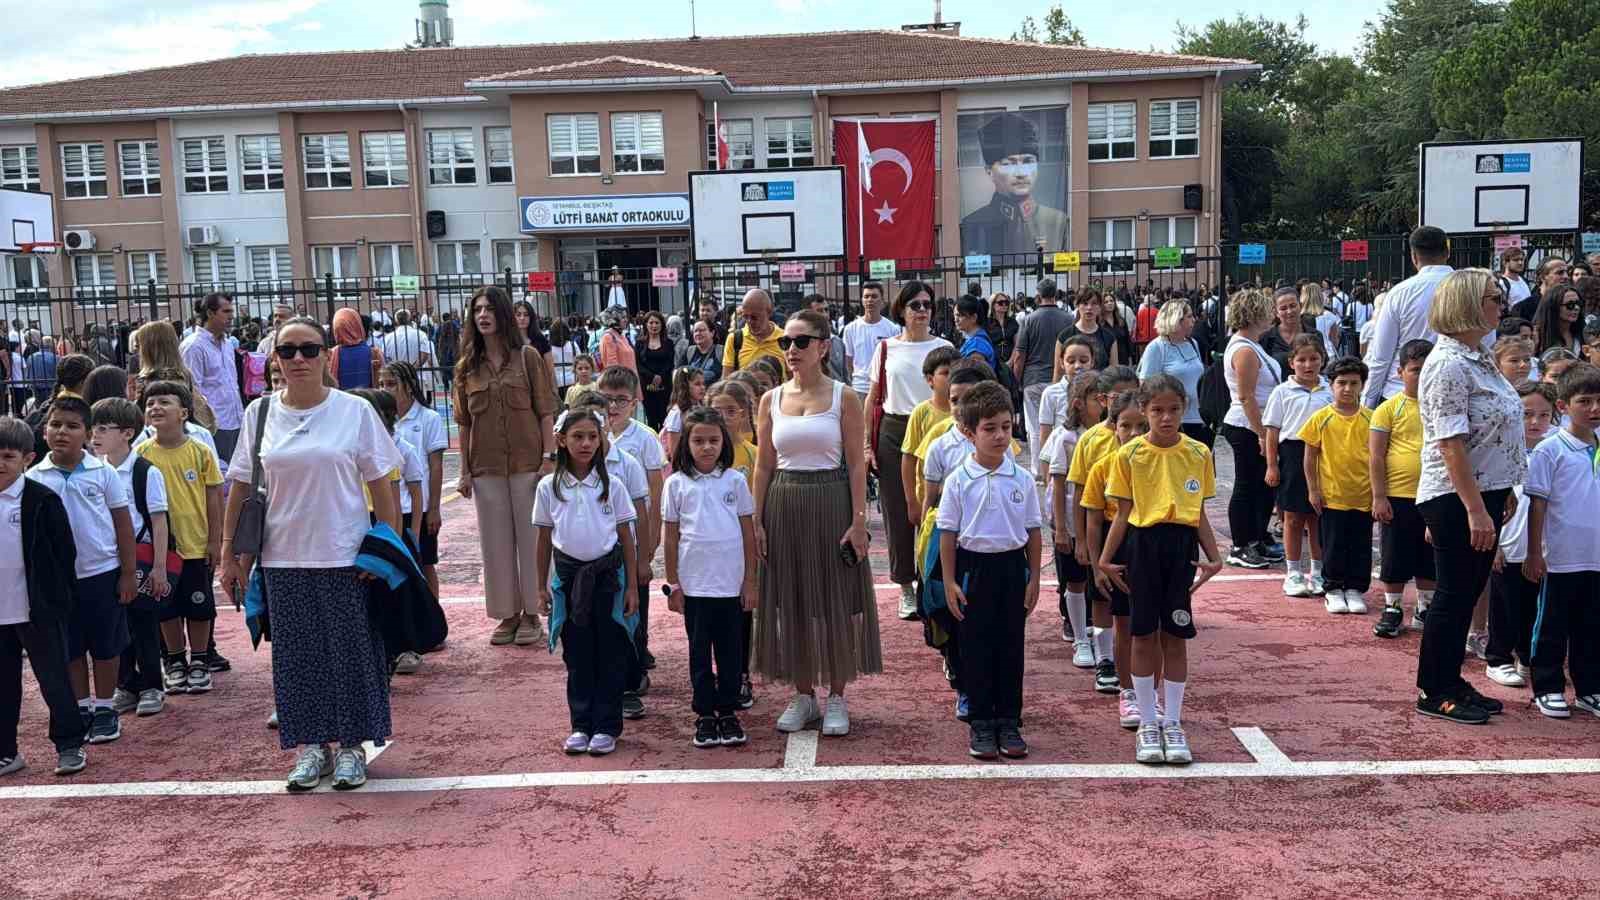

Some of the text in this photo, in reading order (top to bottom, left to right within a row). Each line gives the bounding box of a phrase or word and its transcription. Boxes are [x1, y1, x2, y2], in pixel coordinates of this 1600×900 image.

[553, 210, 684, 225] LÜTFİ BANAT ORTAOKULU
